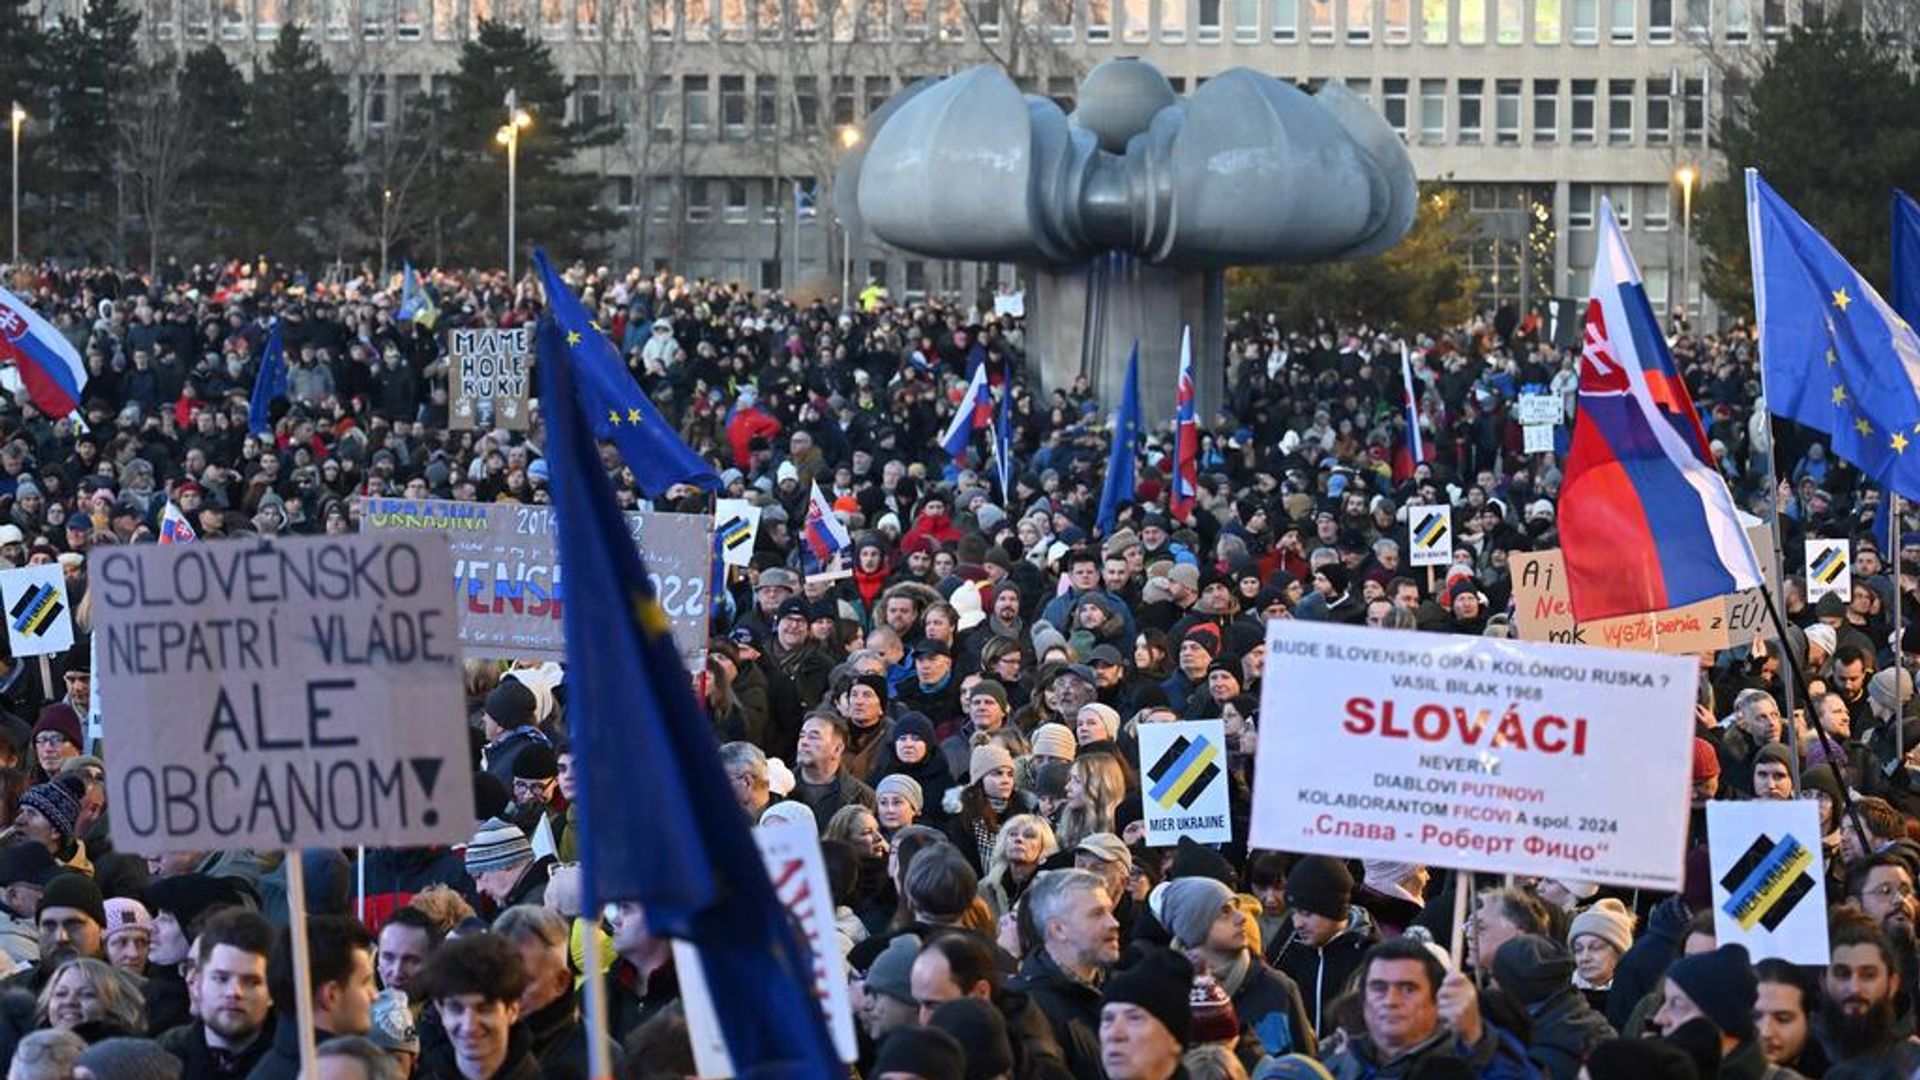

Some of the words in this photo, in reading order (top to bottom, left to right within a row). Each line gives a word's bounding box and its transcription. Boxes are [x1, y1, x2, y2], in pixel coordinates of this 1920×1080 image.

[462, 357, 523, 378] HOLE
[463, 380, 521, 397] RUKY
[370, 500, 487, 529] UKRAJINA
[1711, 617, 1721, 630] z
[108, 606, 277, 674] NEPATRÍ
[1273, 639, 1320, 658] BUDE
[1325, 644, 1432, 667] SLOVENSKO
[1492, 660, 1586, 682] KOLÓNIOU
[1592, 669, 1654, 687] RUSKA
[1661, 676, 1670, 688] ?
[1392, 675, 1440, 692] VASIL
[1446, 678, 1498, 697] BILAK
[1506, 686, 1543, 700] 1968
[204, 679, 358, 751] ALE
[1343, 696, 1588, 756] SLOVÁCI
[124, 754, 443, 843] OBČANOM!
[1374, 773, 1457, 794] DIABLOVI
[1461, 781, 1544, 802] PUTINOVI
[1150, 818, 1175, 832] MIER
[1177, 815, 1225, 830] UKRAJINE
[1297, 788, 1448, 816] KOLABORANTOM
[1453, 804, 1512, 824] FICOVI
[1516, 812, 1527, 825] A
[1533, 815, 1572, 831] spol.
[1578, 817, 1618, 833] 2024
[1421, 824, 1515, 855] Роберт
[1731, 889, 1761, 921] MIER
[1754, 841, 1805, 897] UKRAJINE
